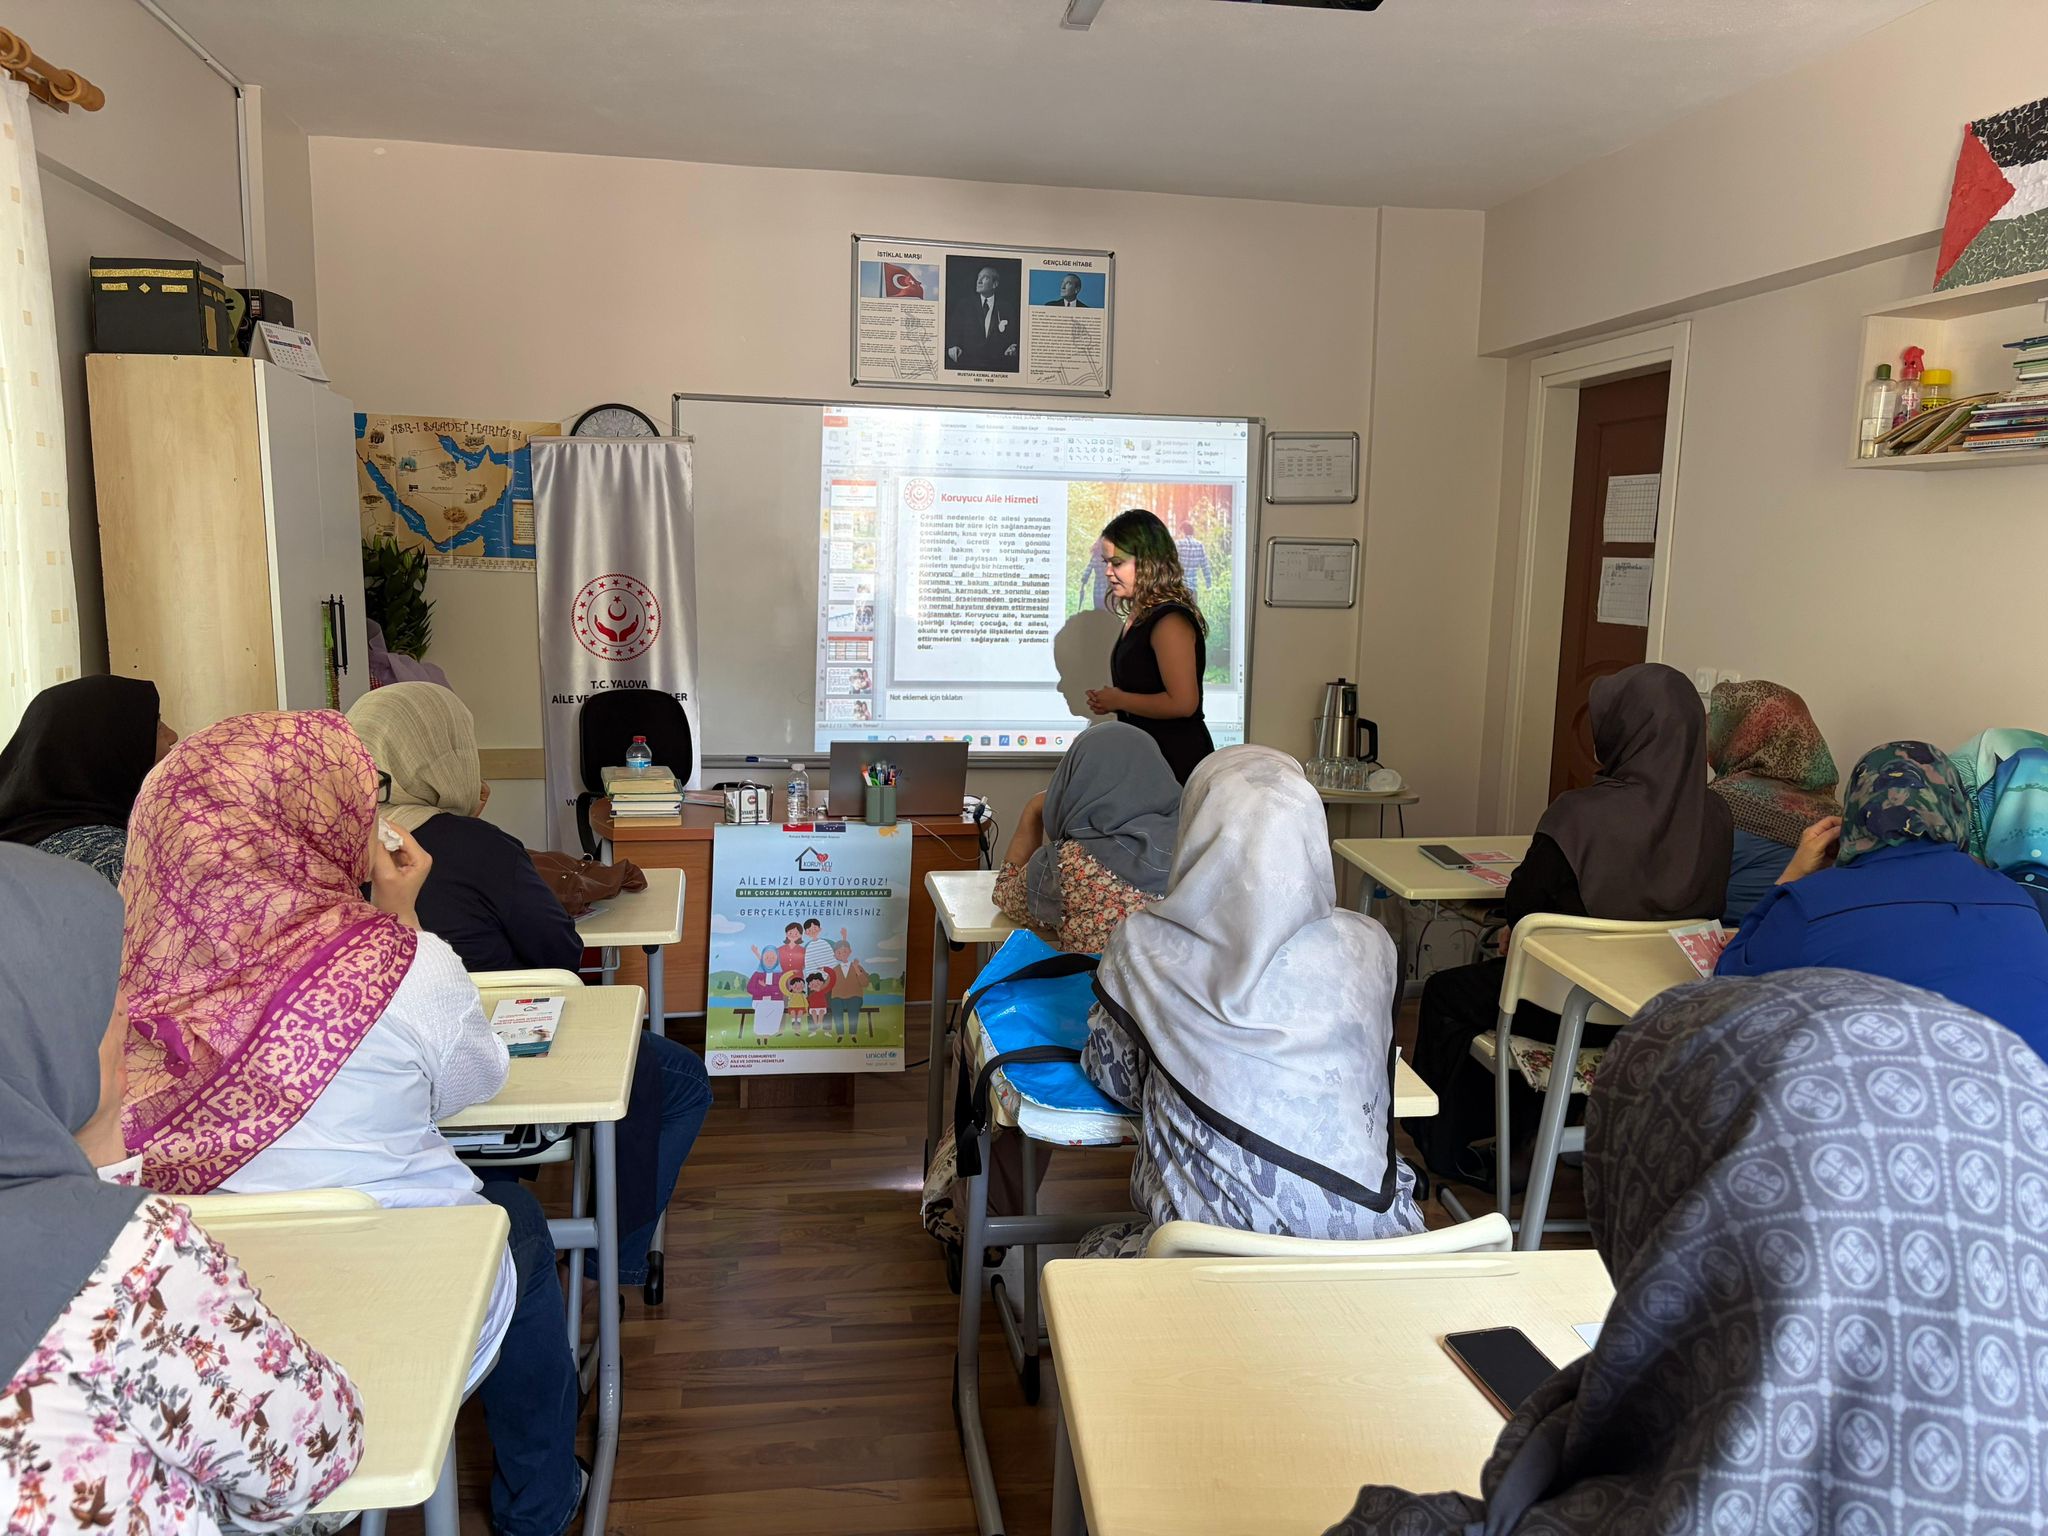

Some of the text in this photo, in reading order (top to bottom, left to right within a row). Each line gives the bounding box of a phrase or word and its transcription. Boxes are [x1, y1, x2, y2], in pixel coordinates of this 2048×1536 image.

[877, 250, 903, 258] İSTİKLAL
[423, 421, 469, 433] SAADET
[941, 493, 1039, 504] Koruyucu Aile Hizmeti
[590, 680, 648, 689] T.C. YALOVA
[552, 694, 589, 704] AİLE VE
[930, 694, 941, 702] için
[739, 876, 888, 886] AİLEMİZİ BÜYÜTÜYORUZ!
[779, 900, 849, 908] HAYALLERİNİ
[740, 908, 881, 918] GERÇEKLEŞTİREBİLİRSİNİZ
[866, 1051, 888, 1059] unicef
